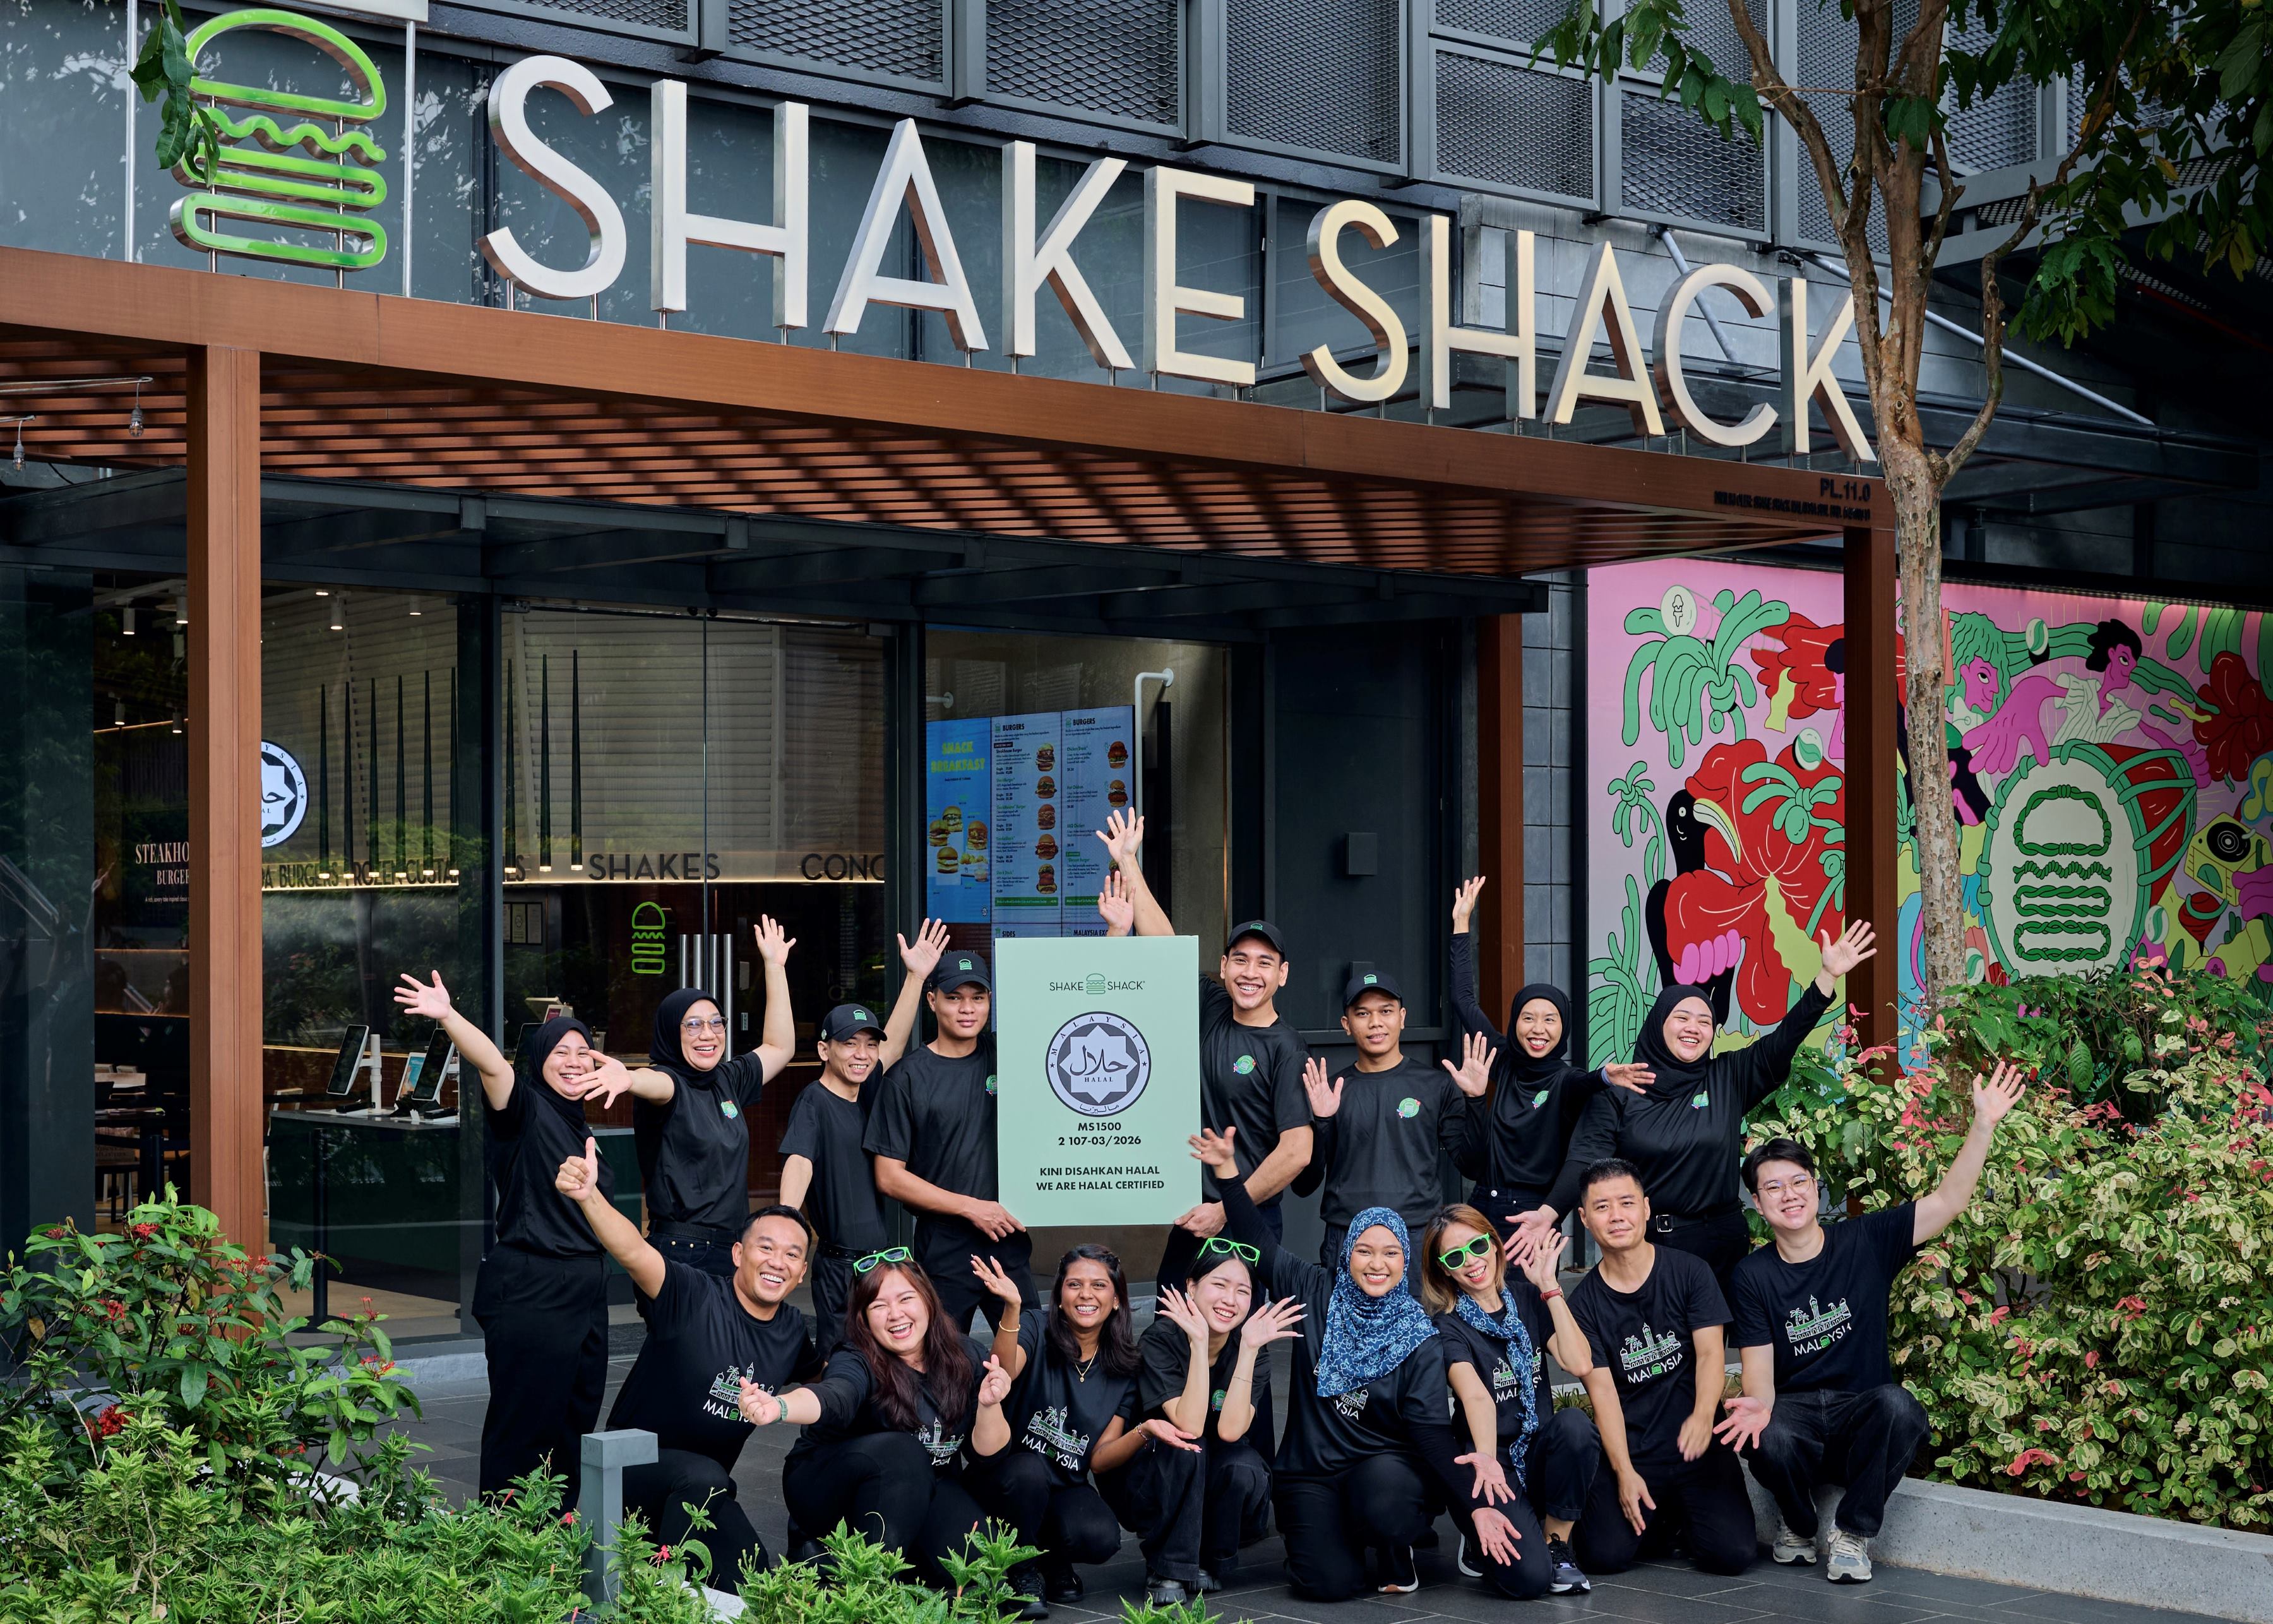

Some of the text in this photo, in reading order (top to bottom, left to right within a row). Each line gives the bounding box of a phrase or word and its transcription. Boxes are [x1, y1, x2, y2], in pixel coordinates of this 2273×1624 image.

[478, 54, 1878, 461] SHAKE SHACK
[1820, 477, 1871, 501] PL.11.0
[1073, 717, 1096, 725] BURGERS
[1002, 723, 1025, 731] BURGERS
[588, 853, 720, 880] SHAKES
[1049, 982, 1084, 991] SHAKE
[1051, 1016, 1145, 1056] MALAYSIA
[1070, 1044, 1128, 1076] حلال
[1058, 1136, 1142, 1147] 2 107-03/2026
[1040, 1166, 1160, 1176] KINI DISAHKAN HALAL
[1036, 1180, 1164, 1190] WE ARE HALAL CERTIFIED
